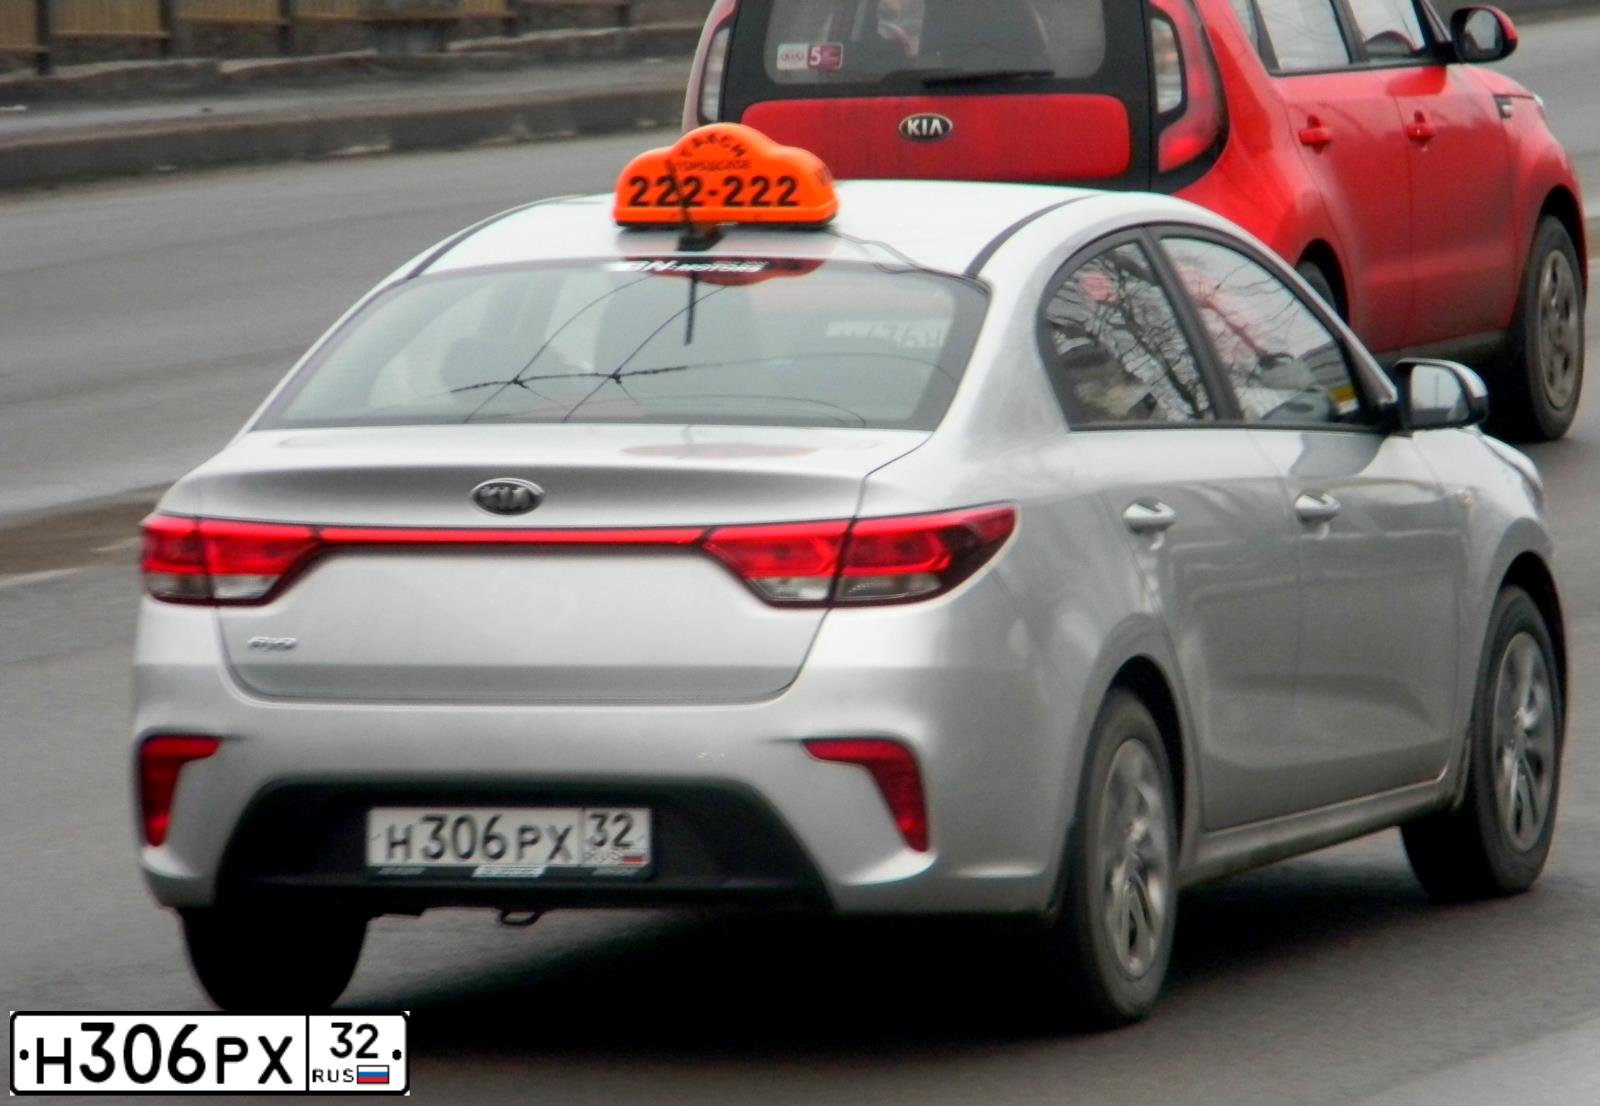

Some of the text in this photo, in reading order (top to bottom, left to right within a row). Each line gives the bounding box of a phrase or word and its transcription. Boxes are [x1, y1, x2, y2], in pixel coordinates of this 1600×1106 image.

[809, 45, 822, 66] 5
[907, 118, 944, 136] KIA
[628, 175, 799, 208] 222-222
[588, 812, 635, 848] 32
